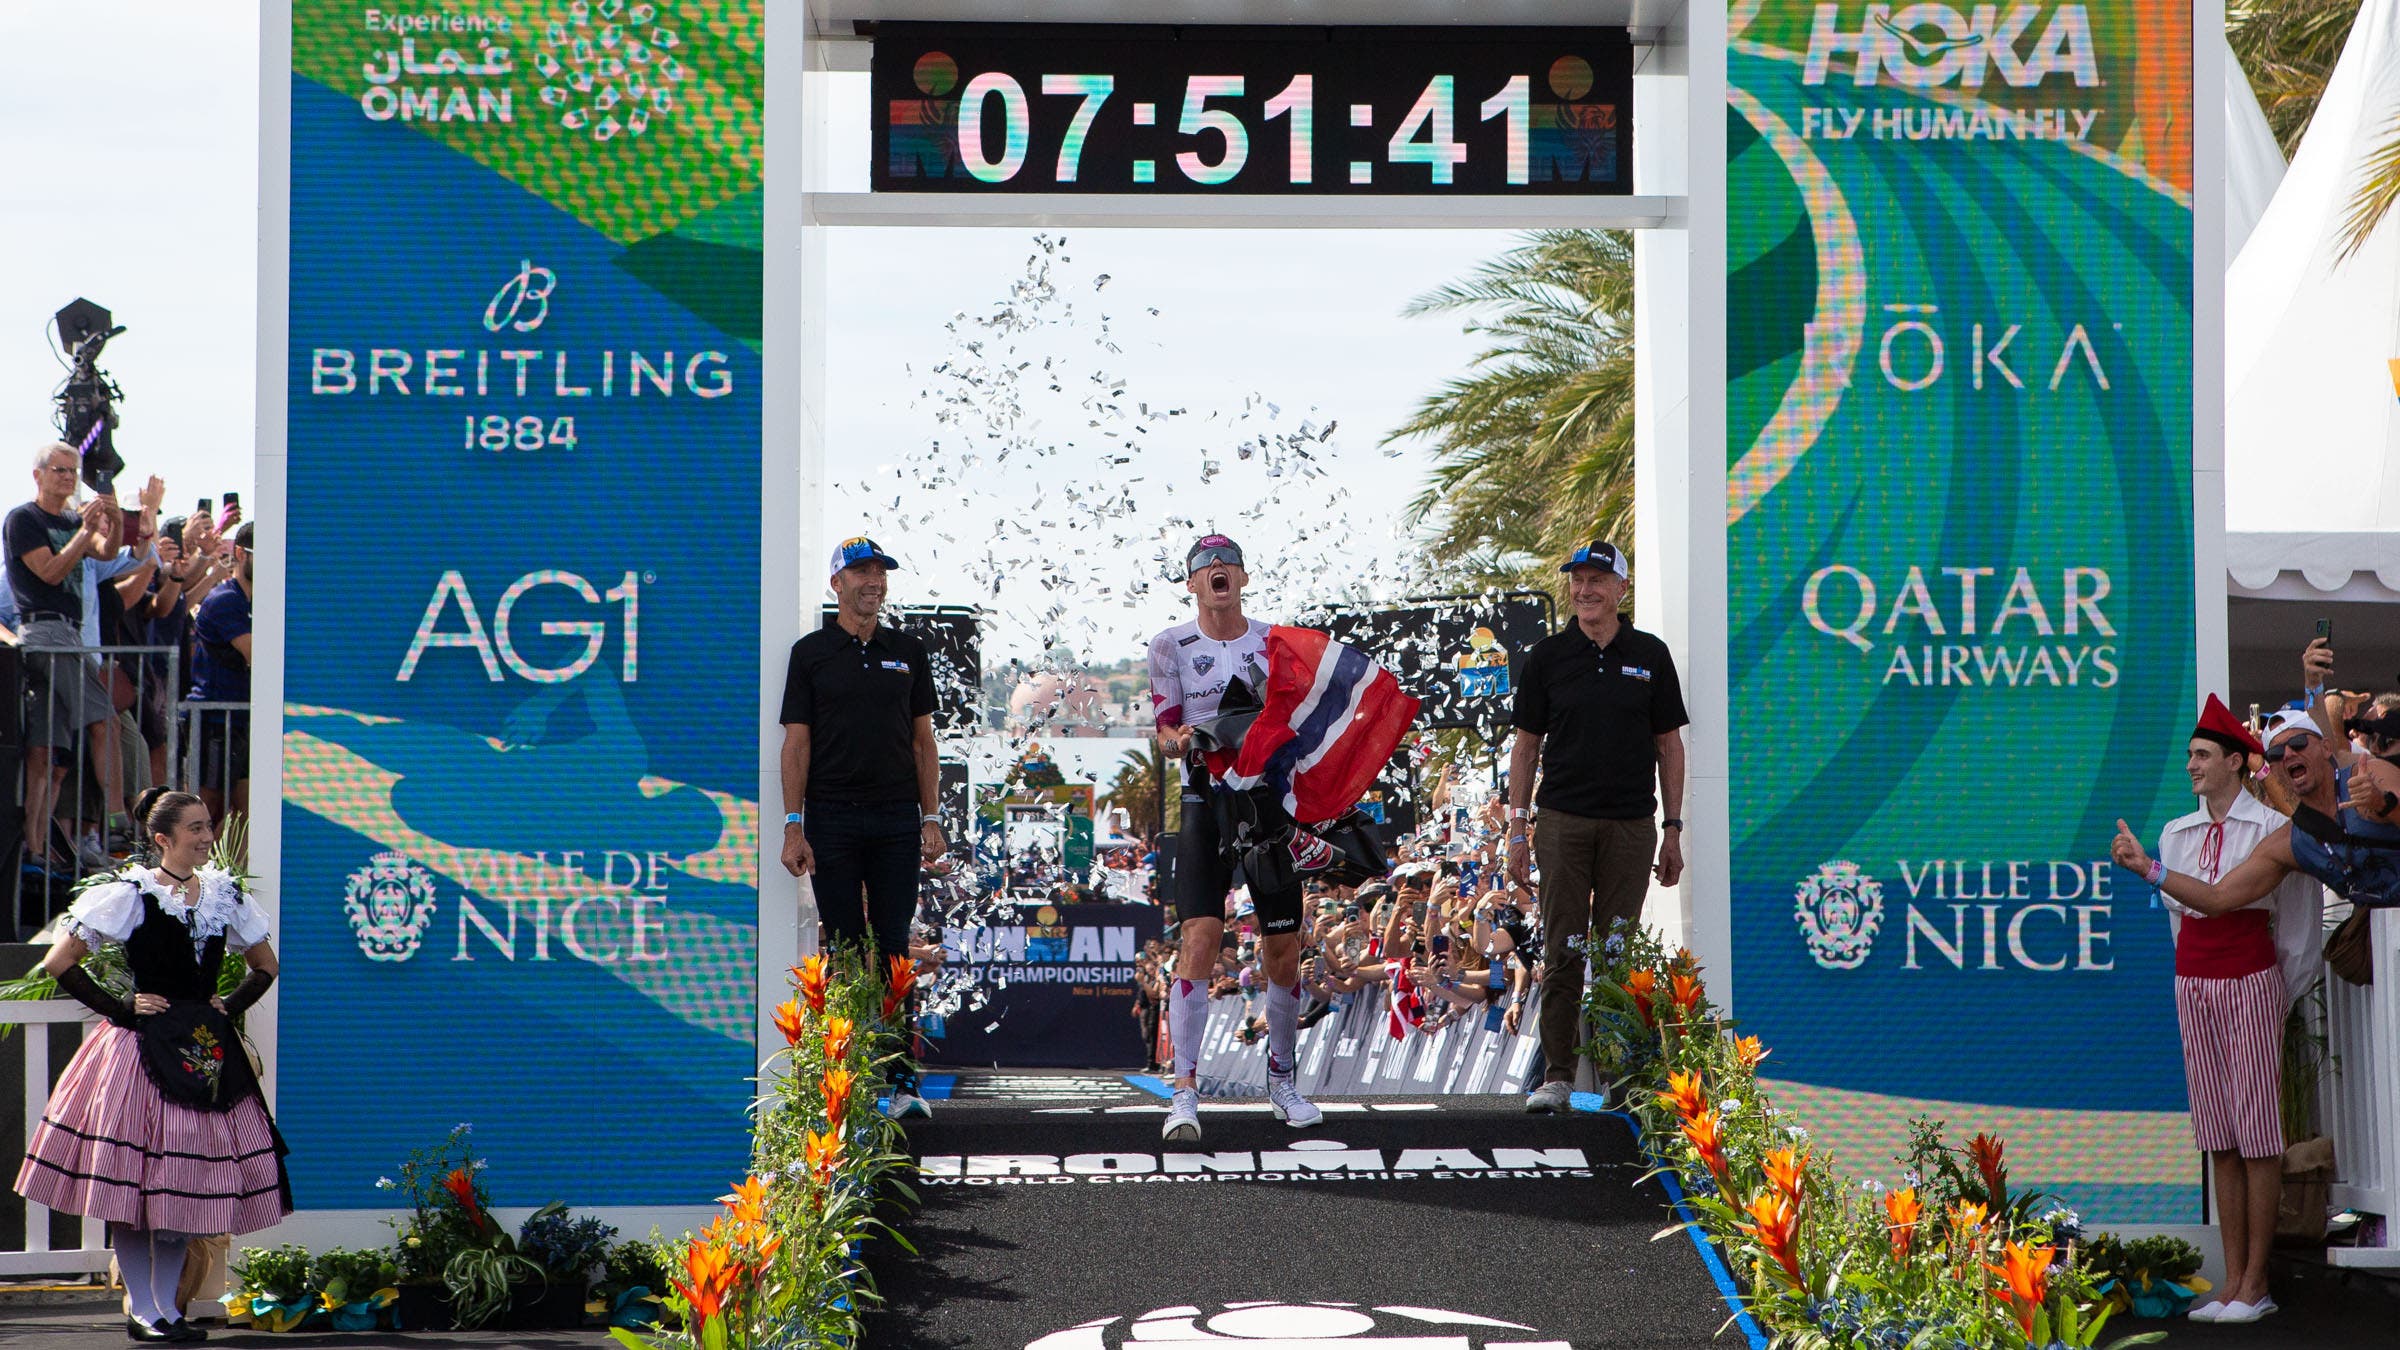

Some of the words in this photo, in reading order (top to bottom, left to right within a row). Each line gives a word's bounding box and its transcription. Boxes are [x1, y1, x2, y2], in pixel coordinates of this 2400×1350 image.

[365, 9, 513, 36] Experience
[1803, 3, 2099, 87] HOKA
[361, 86, 513, 122] OMAN
[957, 72, 1531, 184] 07:51:41
[1802, 108, 1864, 139] FLY
[1873, 108, 2025, 140] HUMAN
[2034, 109, 2099, 140] FLY
[312, 348, 733, 398] BREITLING
[465, 415, 578, 451] 1884
[1802, 565, 2118, 653] QATAR
[1882, 645, 2119, 688] AIRWAYS
[453, 851, 586, 890] VILLE
[603, 851, 670, 890] DE
[1898, 861, 2031, 900] VILLE
[2048, 861, 2114, 900] DE
[451, 895, 669, 962] NICE
[1267, 918, 1295, 929] sailfish
[1901, 904, 2114, 972] NICE
[987, 966, 1135, 985] CHAMPIONSHIP
[1072, 986, 1094, 996] Nice
[1102, 986, 1132, 997] France
[920, 1141, 1590, 1176] IRONMAN
[918, 1175, 1076, 1186] WORLD
[1088, 1171, 1420, 1186] CHAMPIONSHIP
[1431, 1169, 1595, 1180] EVENTS
